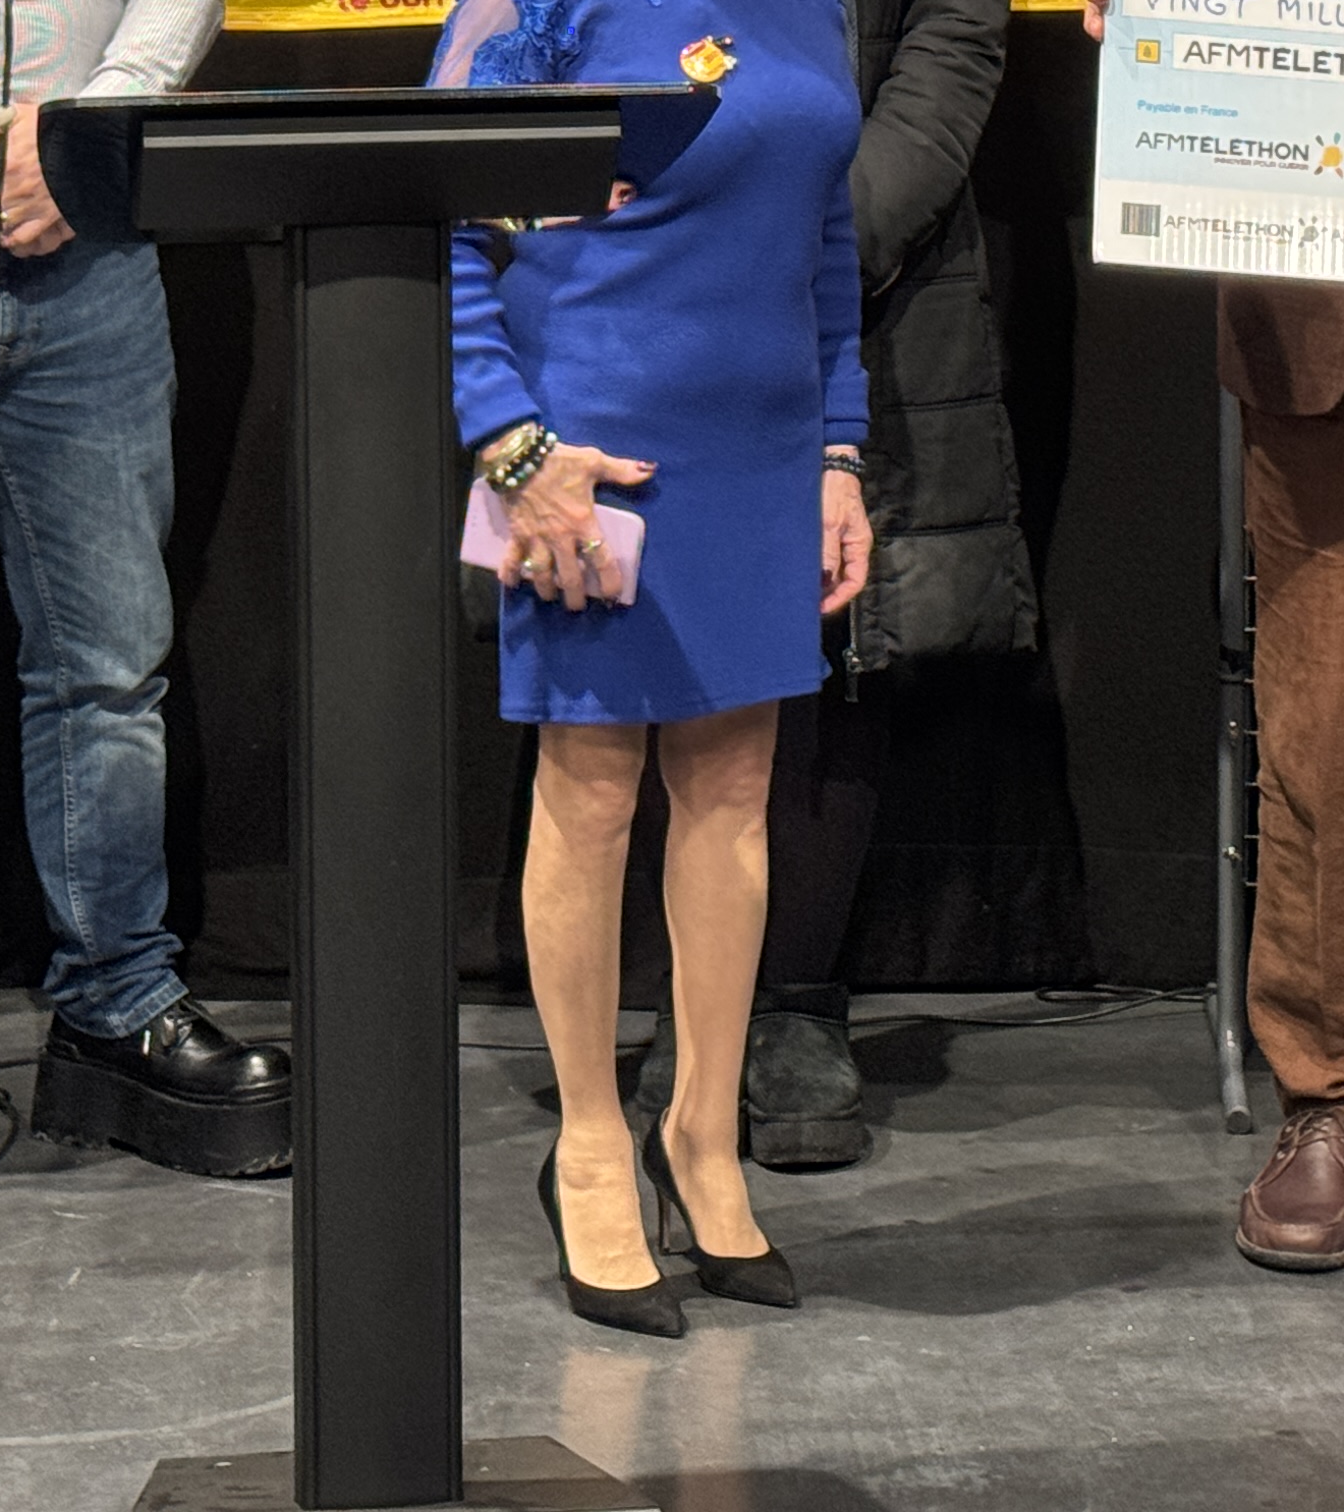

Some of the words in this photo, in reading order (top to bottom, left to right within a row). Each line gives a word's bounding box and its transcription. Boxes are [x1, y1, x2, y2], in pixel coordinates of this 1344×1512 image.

[1137, 100, 1181, 113] Payable
[1184, 105, 1198, 114] en
[1201, 105, 1238, 117] France
